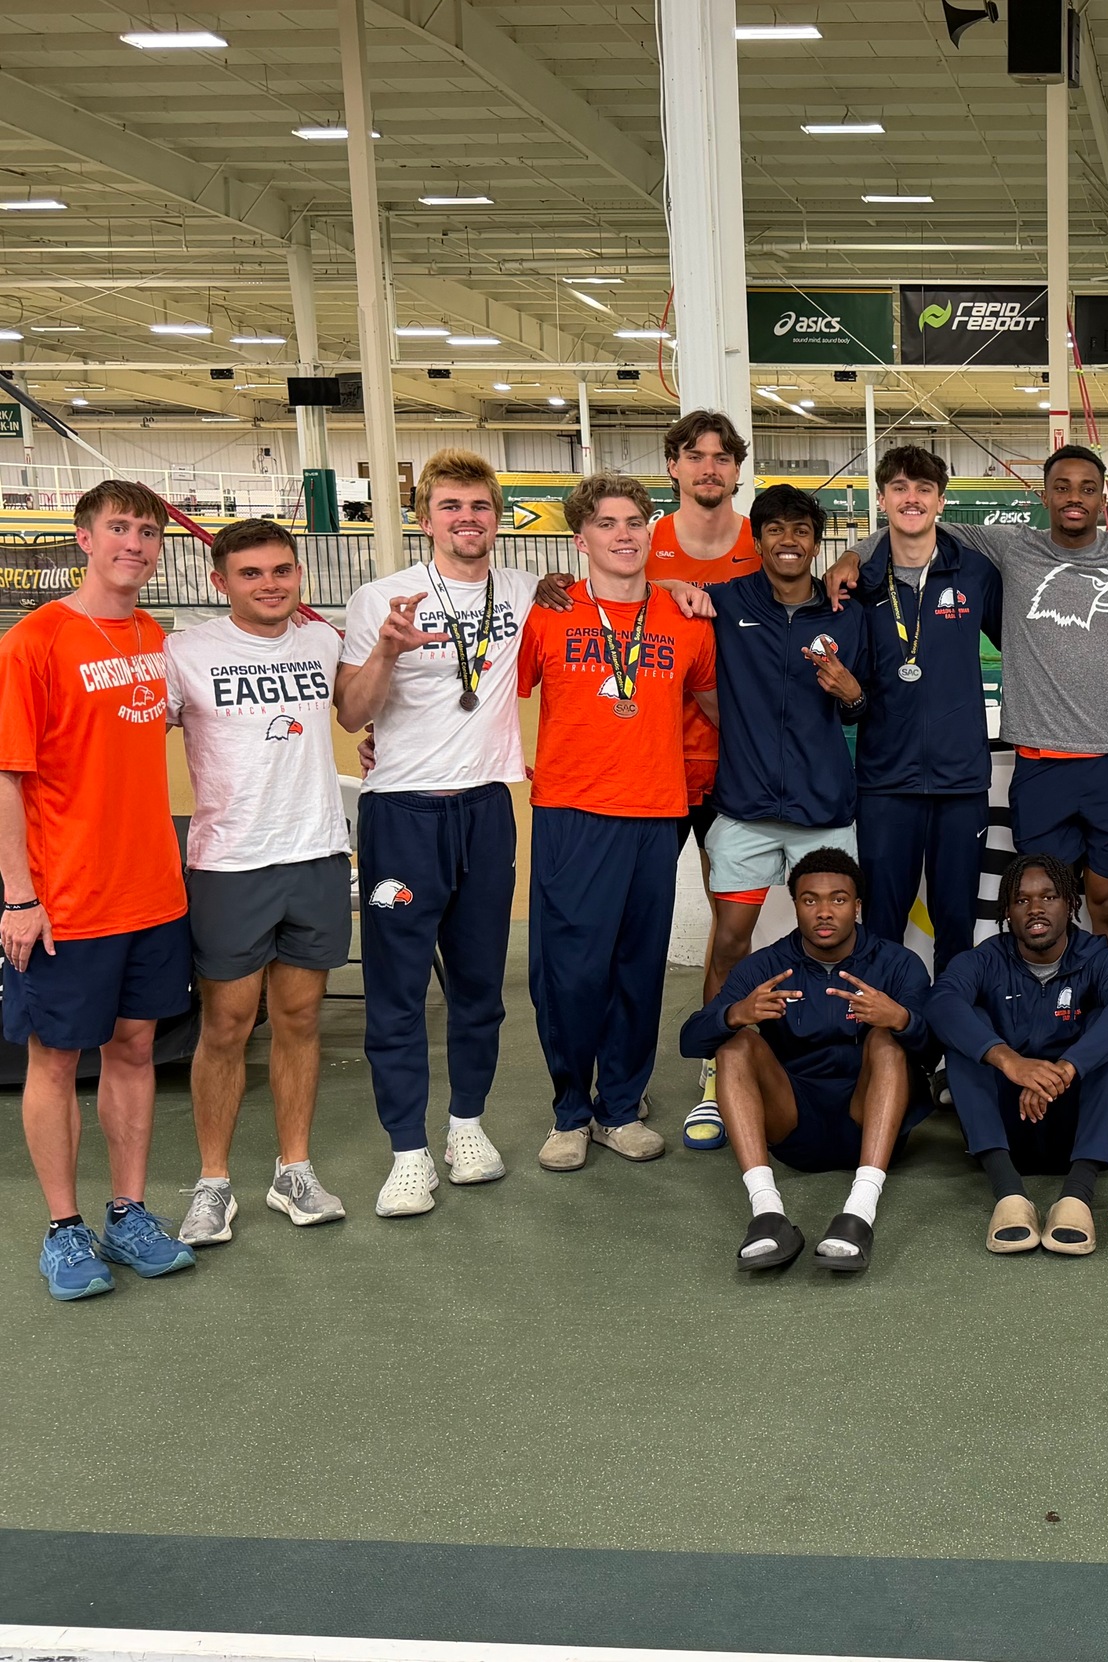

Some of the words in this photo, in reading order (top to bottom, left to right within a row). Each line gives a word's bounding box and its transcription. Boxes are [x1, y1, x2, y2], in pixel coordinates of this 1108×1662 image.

[795, 317, 841, 333] asics
[1000, 511, 1031, 524] asics
[658, 550, 675, 558] SAC
[21, 598, 36, 606] SAC
[210, 660, 323, 677] CARSON-NEWMAN
[563, 664, 605, 673] TRACK
[901, 668, 920, 678] SAC
[212, 671, 330, 707] EAGLES
[117, 697, 167, 723] ATHLETICS
[214, 704, 267, 717] TRACK
[615, 703, 636, 713] SAC
